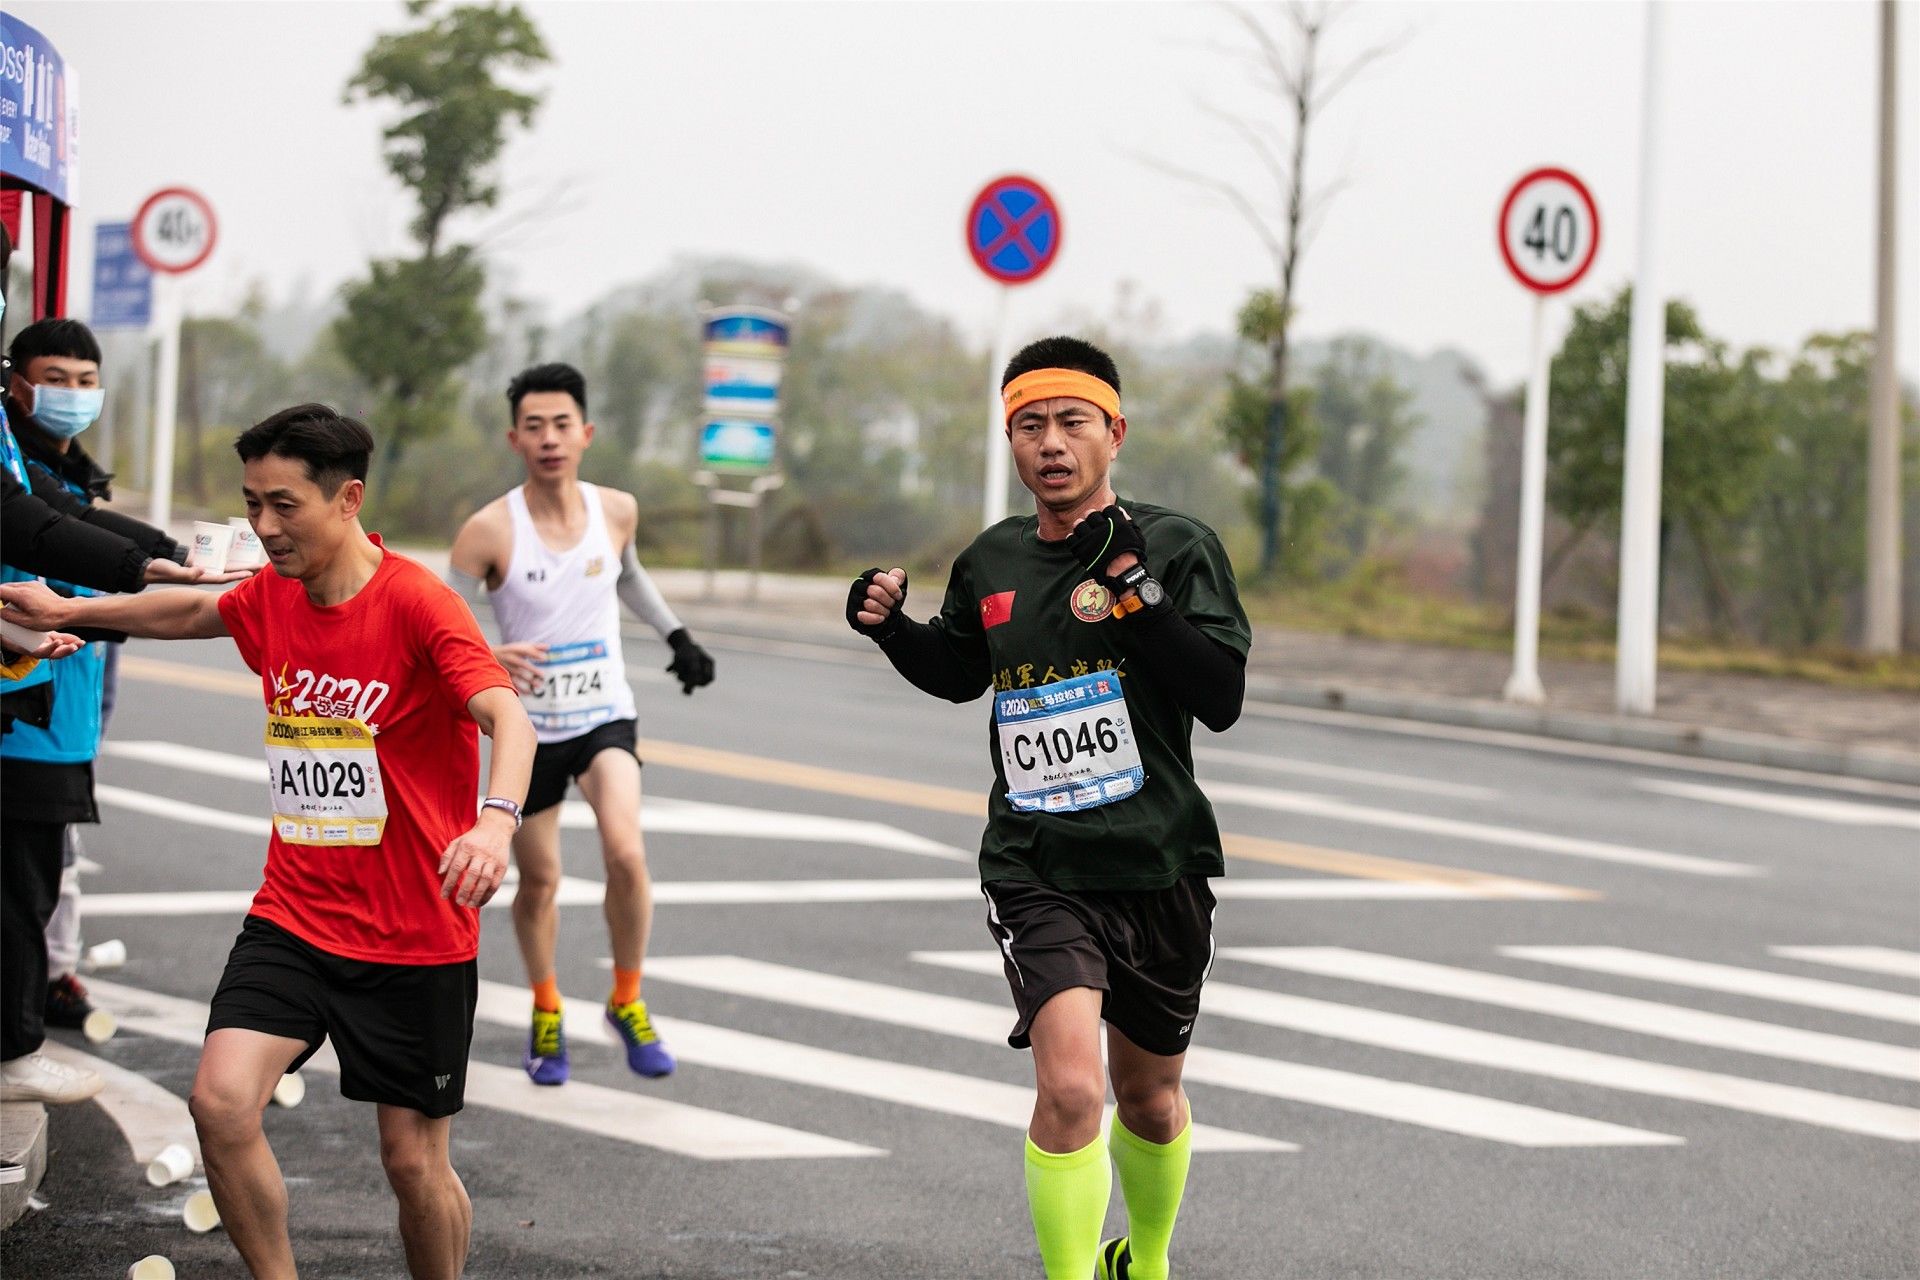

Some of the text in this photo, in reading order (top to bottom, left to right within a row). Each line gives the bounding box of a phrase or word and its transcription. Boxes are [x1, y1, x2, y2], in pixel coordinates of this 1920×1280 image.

[1524, 206, 1577, 261] 40
[530, 671, 601, 698] C1724
[1014, 717, 1118, 771] C1046
[281, 760, 366, 798] A1029
